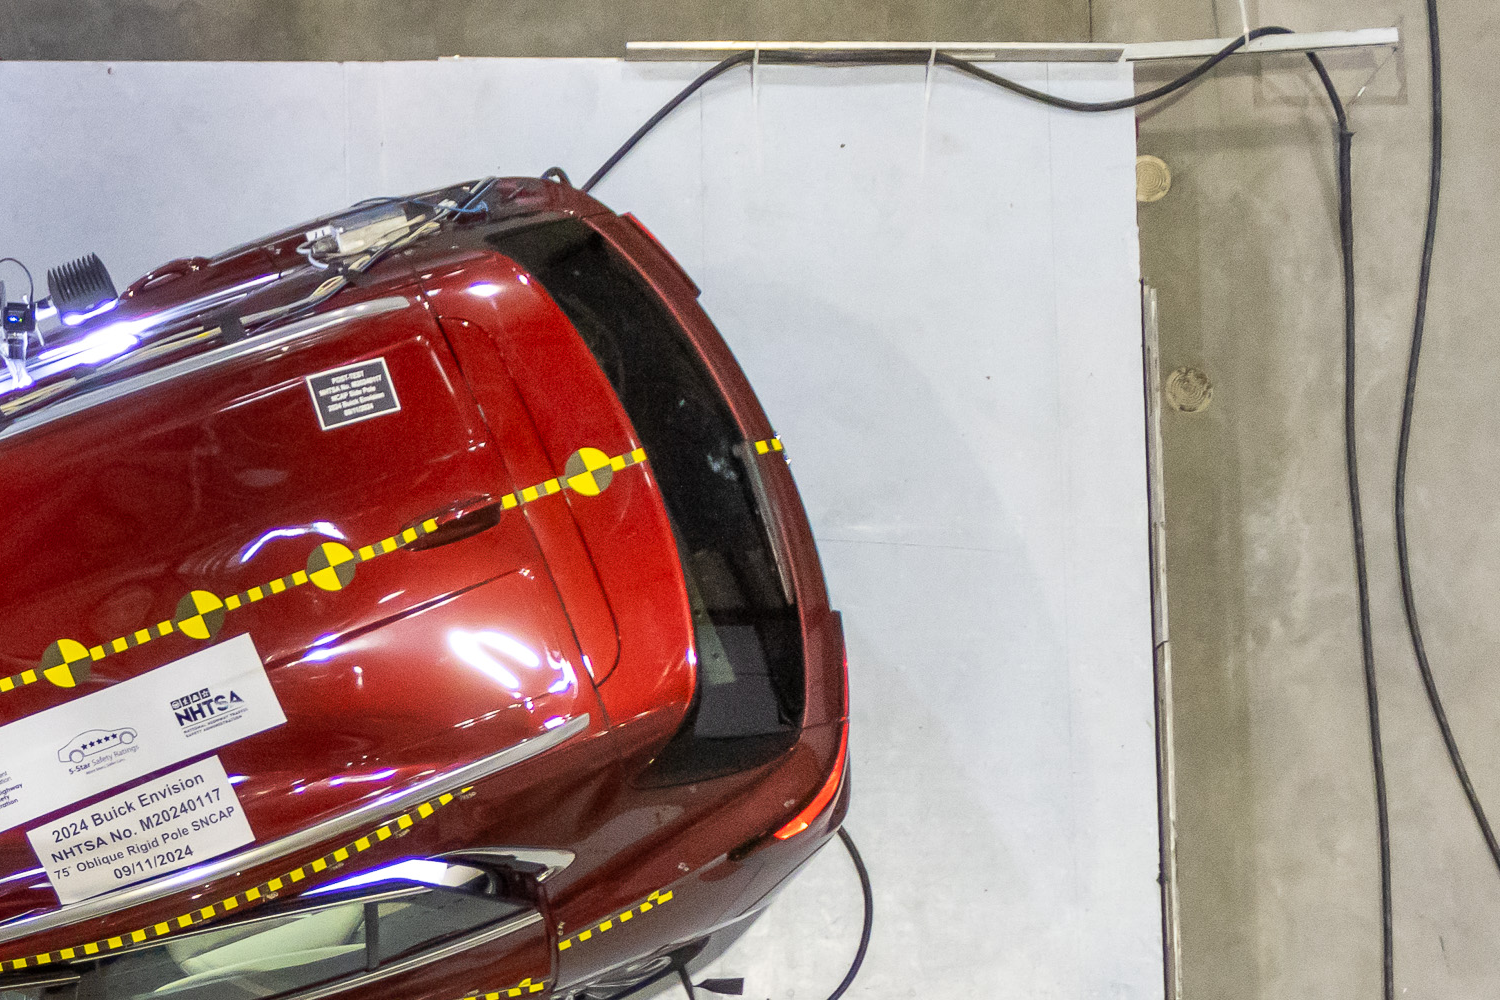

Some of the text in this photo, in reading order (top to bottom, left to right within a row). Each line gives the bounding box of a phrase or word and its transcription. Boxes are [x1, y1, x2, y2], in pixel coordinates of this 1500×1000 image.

[174, 690, 244, 726] NHTSA
[68, 744, 139, 775] 5-Star Safety Ratings
[51, 787, 221, 863] NHTSA No. M20240117
[52, 774, 205, 843] 2024 Buick Envision
[76, 851, 124, 872] Oblique
[127, 838, 160, 858] Rigid
[161, 826, 190, 844] Pole
[191, 806, 236, 831] SNCAP
[113, 844, 194, 880] 09/11/2024
